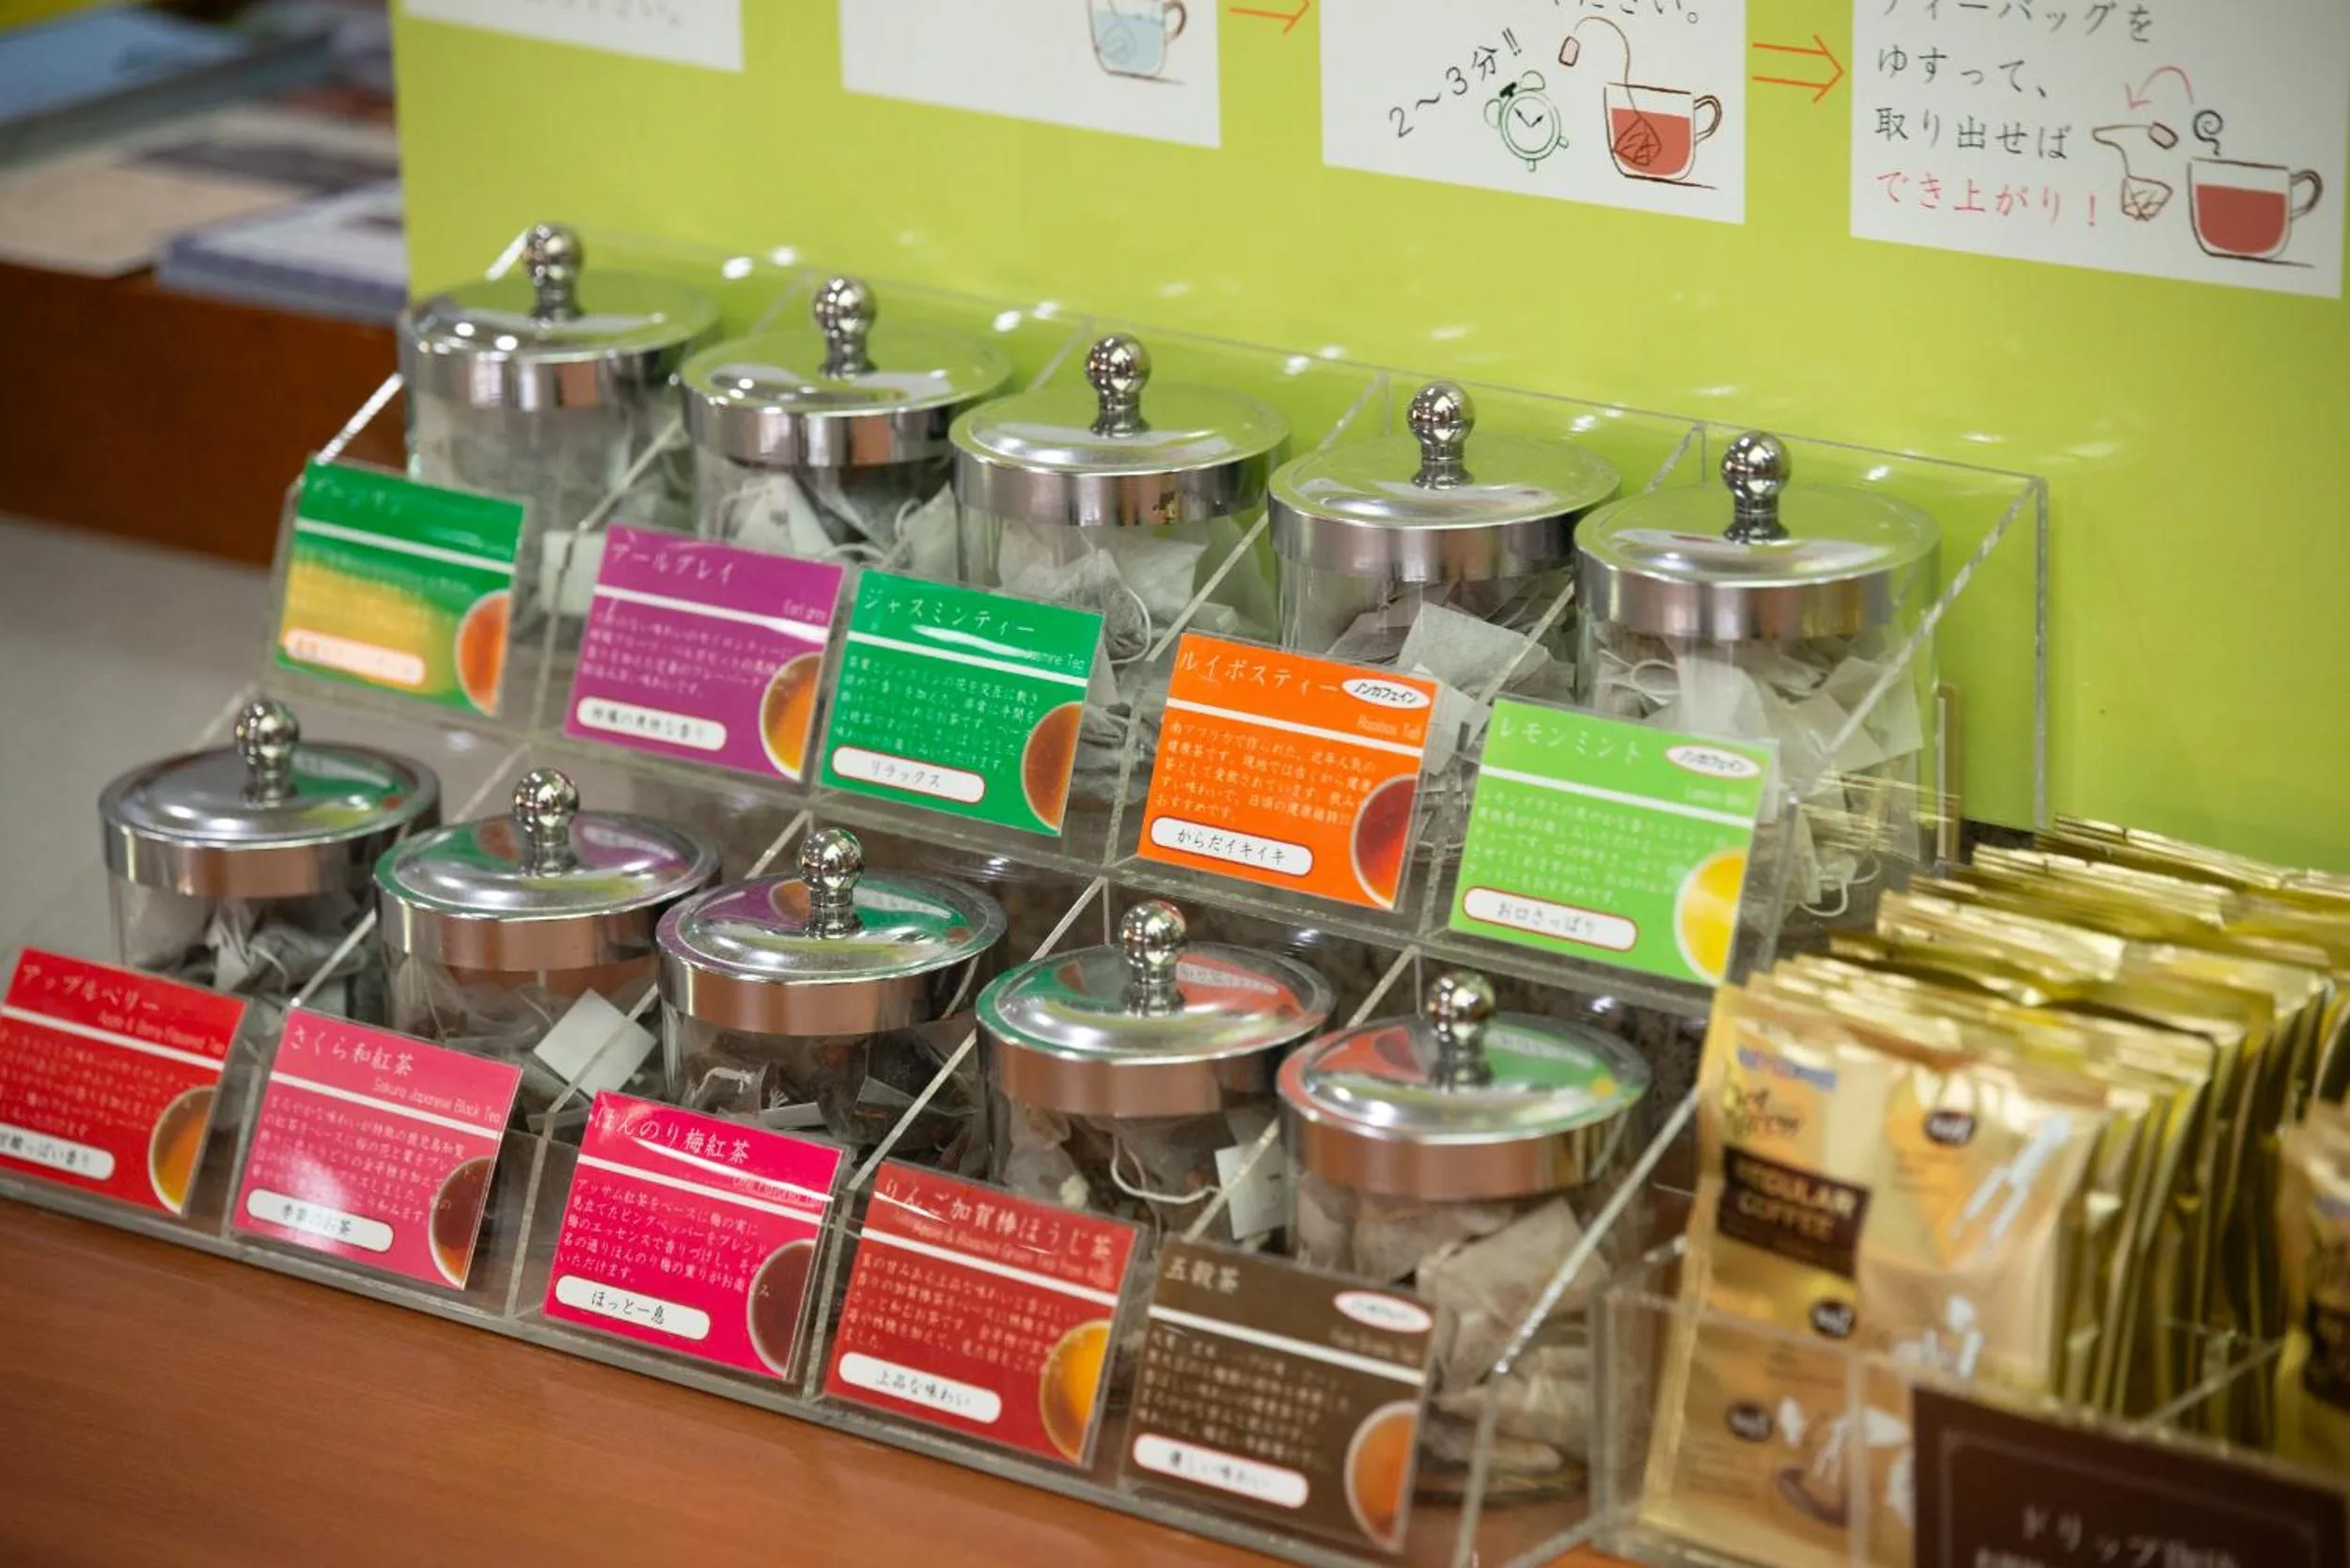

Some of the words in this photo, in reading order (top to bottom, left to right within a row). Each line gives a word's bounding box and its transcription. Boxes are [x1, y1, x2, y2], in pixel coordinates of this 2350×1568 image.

[1878, 44, 2047, 98] ゆすって、
[1874, 106, 2072, 160] 取り出せば
[607, 541, 734, 586] アールグレイ
[863, 587, 1038, 642] ジャスミンティー
[1177, 646, 1341, 702] ルイボスティー
[1497, 715, 1643, 766] レモンミント
[869, 760, 942, 789] リラックス
[1175, 826, 1288, 866] からだイキイキ
[288, 1024, 416, 1078] さくら和紅茶
[594, 1105, 752, 1166] ほんのり梅紅茶
[881, 1177, 1115, 1264] りんご加賀棒ほうじ茶
[557, 1249, 638, 1284] いただけます。
[588, 1287, 667, 1325] ほっと一息
[874, 1366, 974, 1410] 上品な味わい
